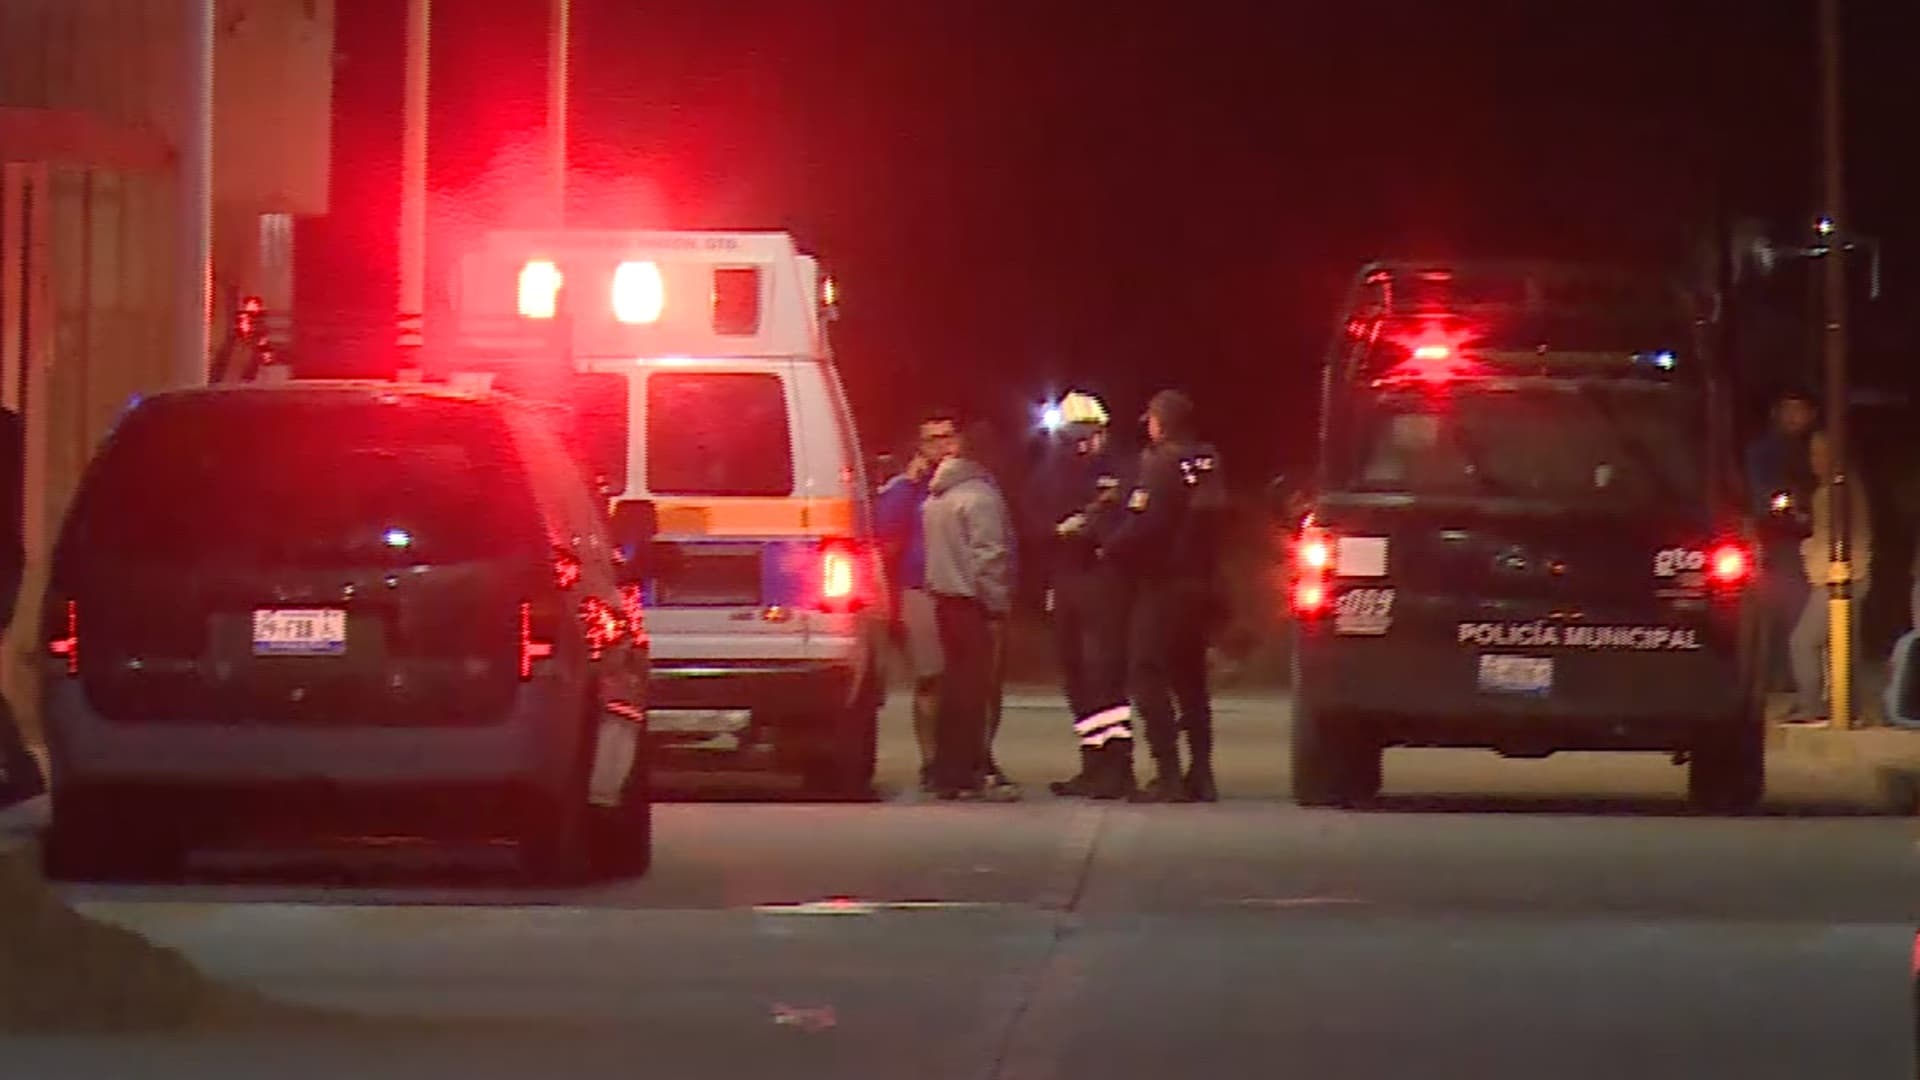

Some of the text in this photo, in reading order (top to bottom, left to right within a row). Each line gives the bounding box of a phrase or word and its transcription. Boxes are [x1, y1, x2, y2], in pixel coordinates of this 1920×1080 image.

[1653, 547, 1705, 577] gto
[1457, 620, 1702, 650] POLICÍA MUNICIPAL
